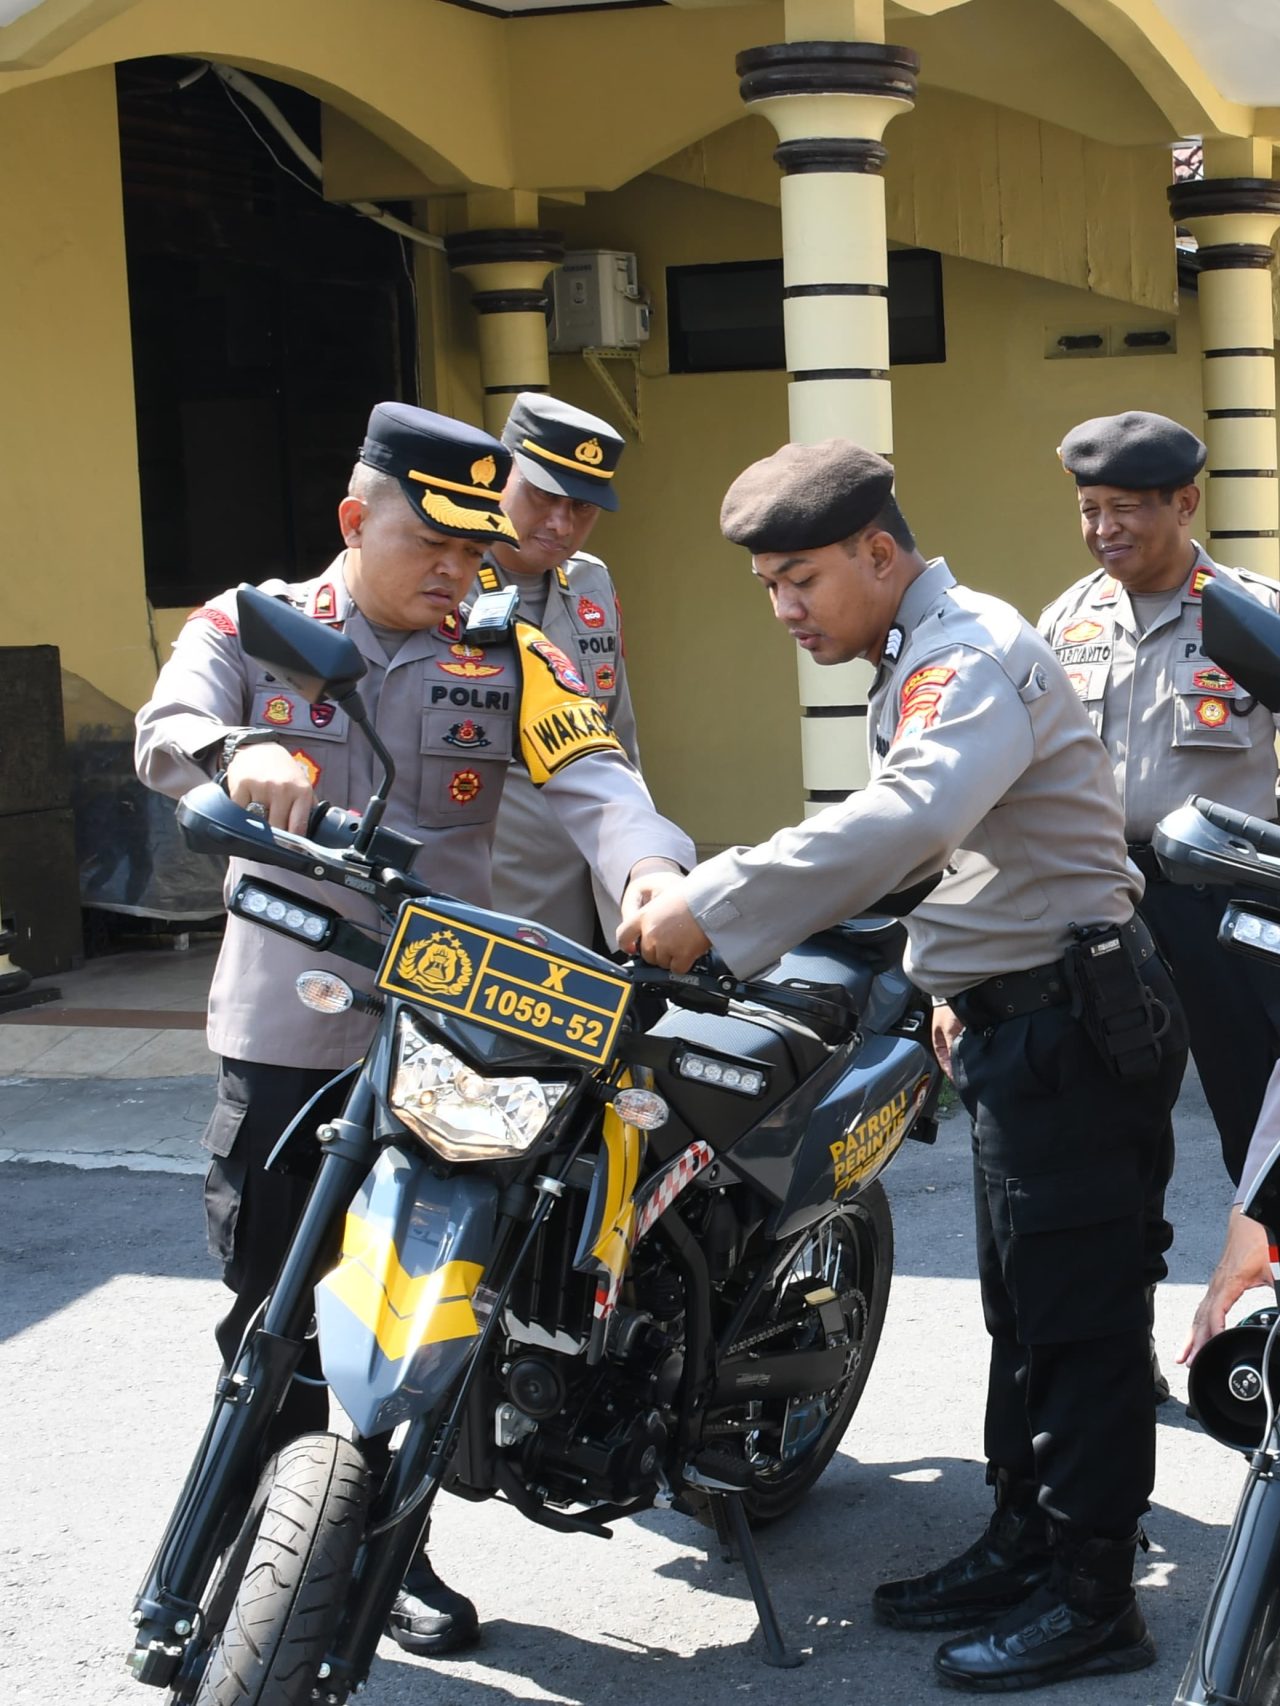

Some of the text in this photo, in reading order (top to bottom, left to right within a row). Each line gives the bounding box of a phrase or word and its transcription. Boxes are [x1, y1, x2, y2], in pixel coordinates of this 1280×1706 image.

[431, 685, 510, 711] POLRI
[541, 962, 571, 993] X
[483, 984, 603, 1047] 1059-52
[829, 1089, 907, 1163] PATROLI
[834, 1111, 906, 1183] PERINTIS
